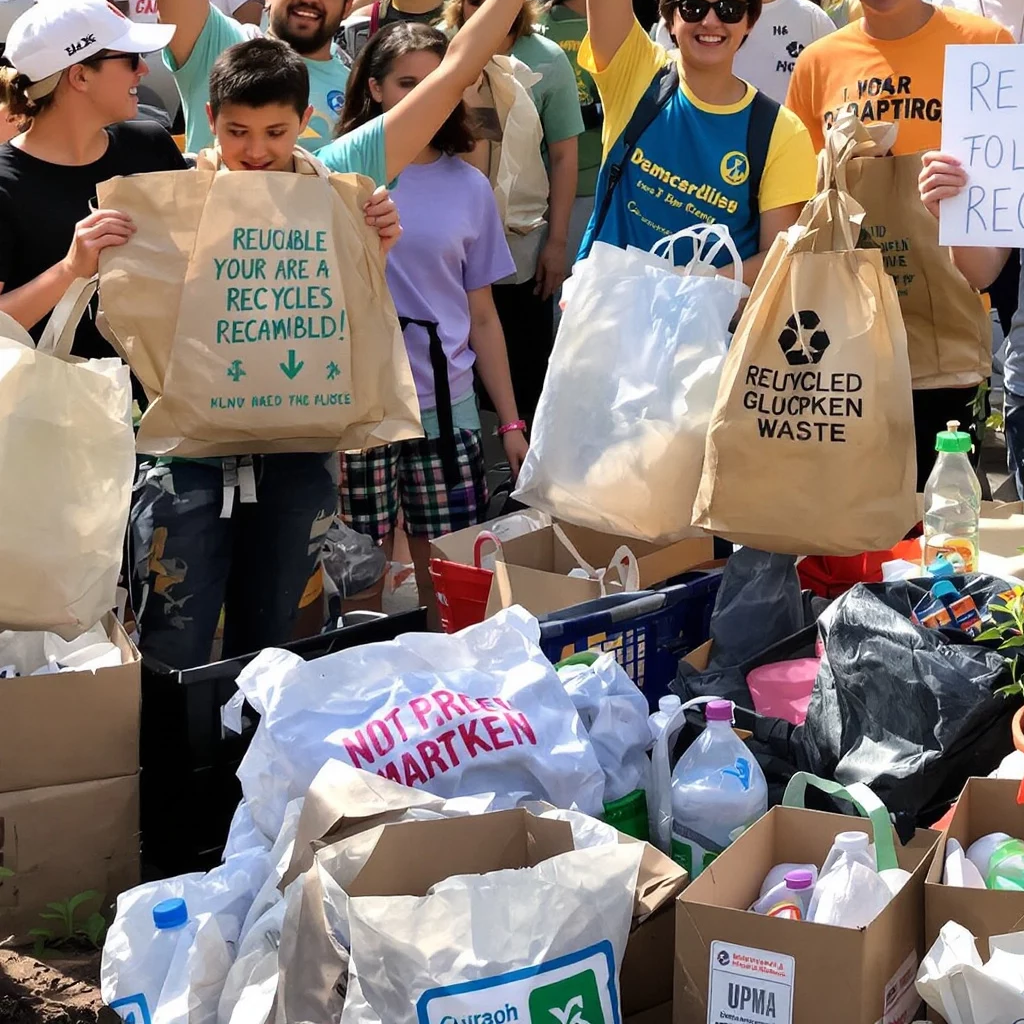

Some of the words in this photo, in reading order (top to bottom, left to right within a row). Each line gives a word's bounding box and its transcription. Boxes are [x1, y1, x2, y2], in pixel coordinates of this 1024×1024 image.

[213, 258, 267, 281] YOUR
[274, 259, 309, 280] ARE
[316, 259, 329, 278] A
[226, 286, 333, 312] RECYCLES
[757, 417, 846, 443] WASTE
[342, 707, 408, 768] NOT
[727, 982, 776, 1019] UPMA
